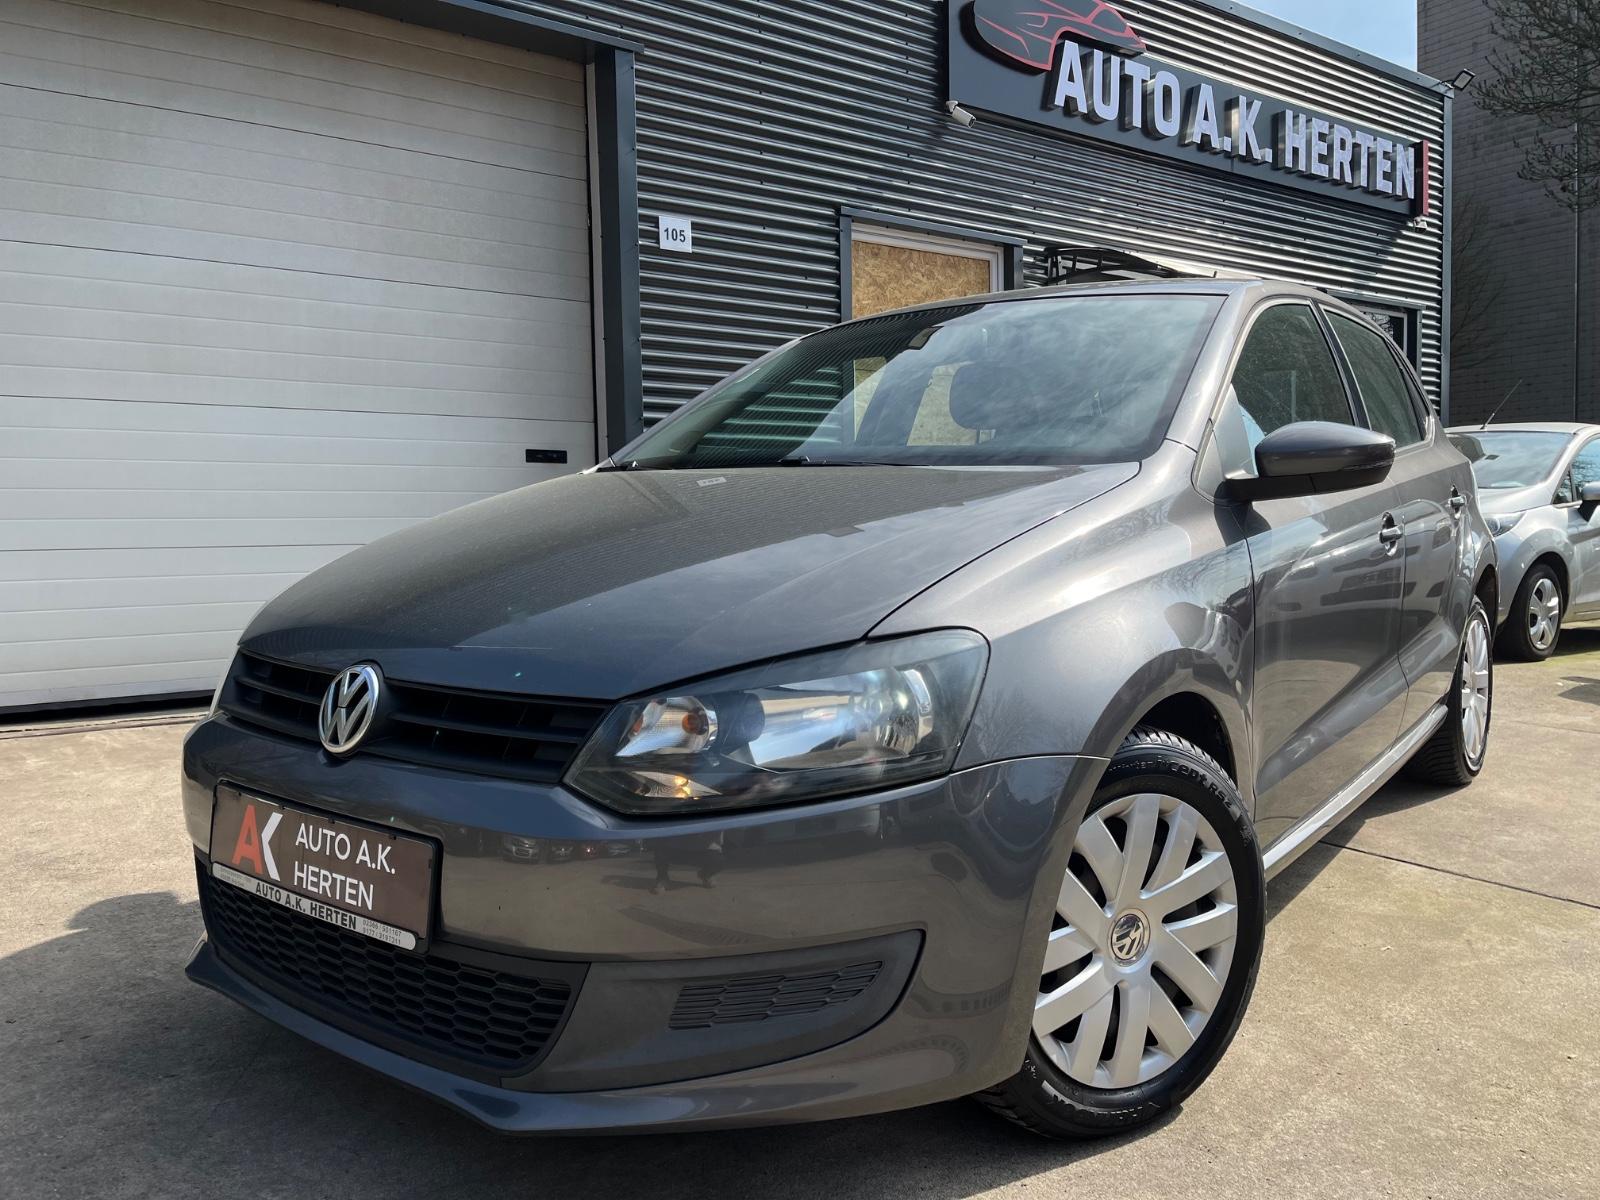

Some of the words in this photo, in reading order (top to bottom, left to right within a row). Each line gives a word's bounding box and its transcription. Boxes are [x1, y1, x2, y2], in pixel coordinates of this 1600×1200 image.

[1054, 40, 1180, 138] AUTO
[1191, 83, 1273, 164] A.K.
[1285, 109, 1416, 200] HERTEN
[664, 227, 686, 243] 105
[319, 664, 379, 753] VW
[231, 804, 284, 882] AK
[295, 822, 351, 861] AUTO
[355, 839, 396, 875] A.K.
[255, 882, 282, 902] AUTO
[284, 893, 306, 913] A.K.
[310, 902, 357, 930] HERTEN
[293, 861, 374, 911] HERTEN
